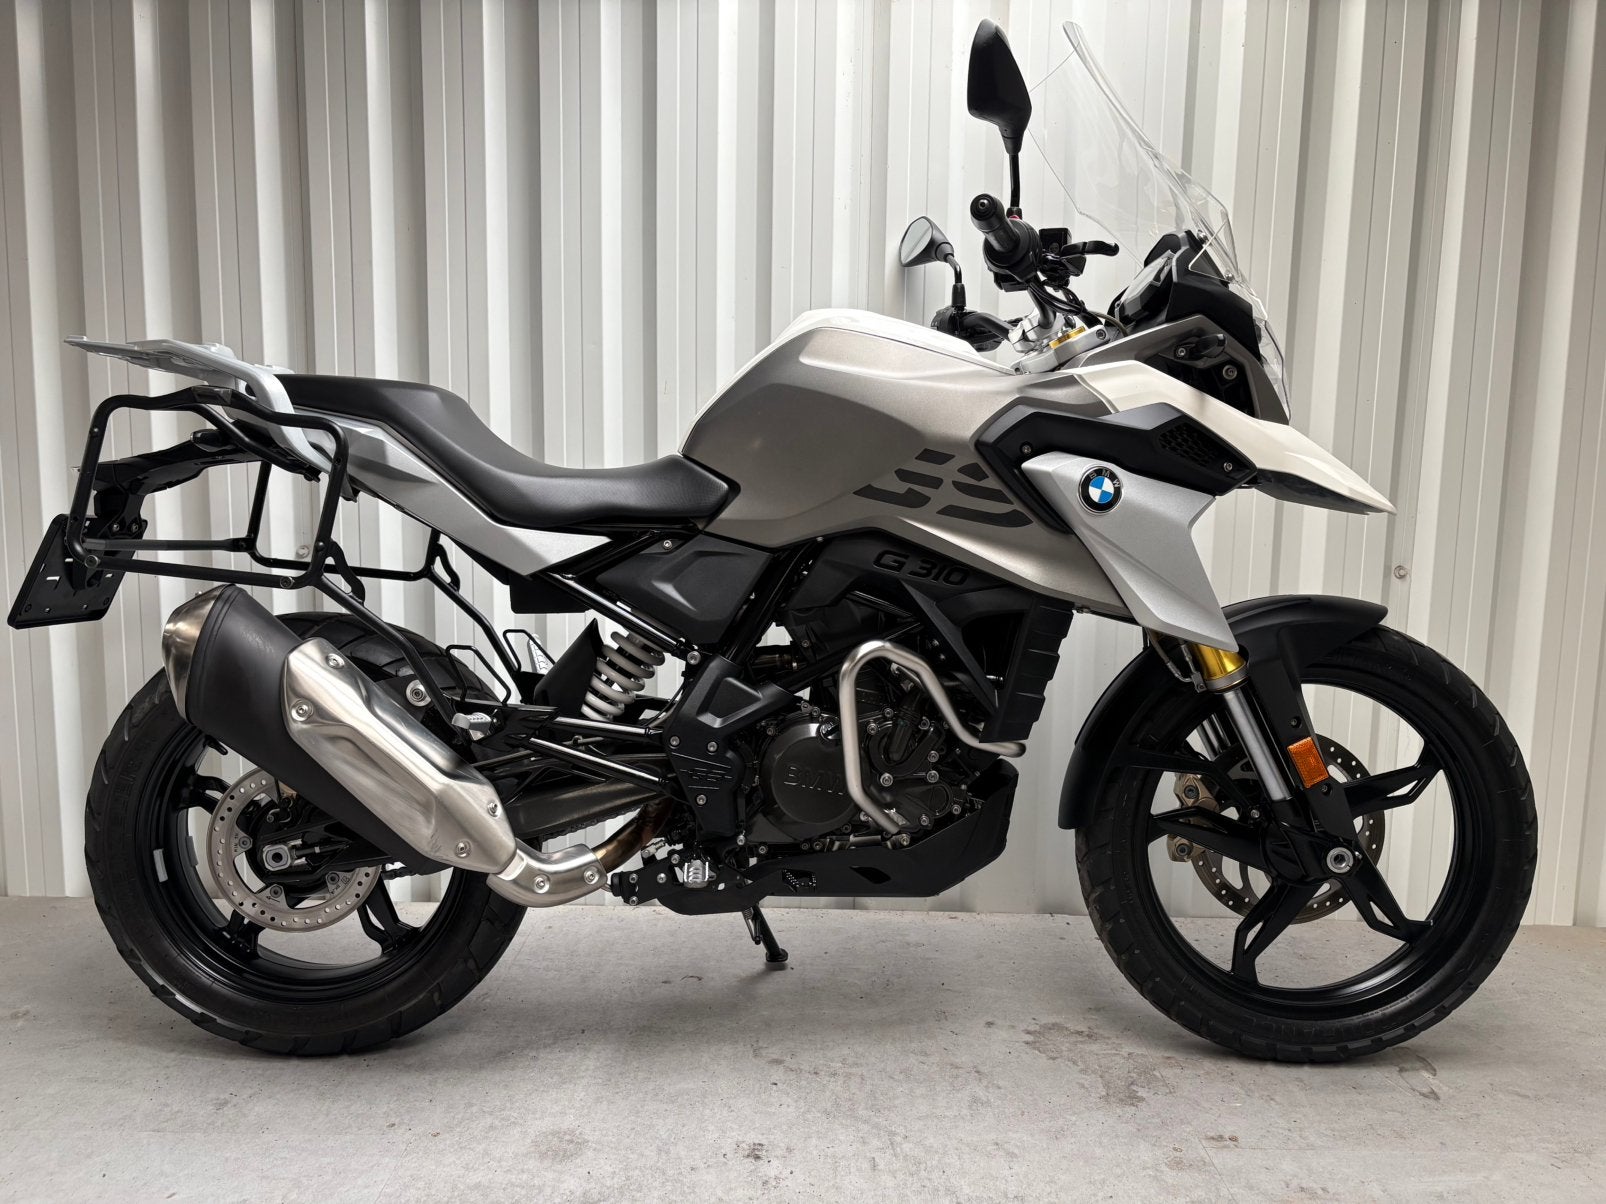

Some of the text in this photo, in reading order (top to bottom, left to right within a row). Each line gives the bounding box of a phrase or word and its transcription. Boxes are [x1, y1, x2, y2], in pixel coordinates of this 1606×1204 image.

[852, 448, 1034, 528] GS
[873, 550, 970, 586] G 310
[783, 762, 848, 796] BMW
